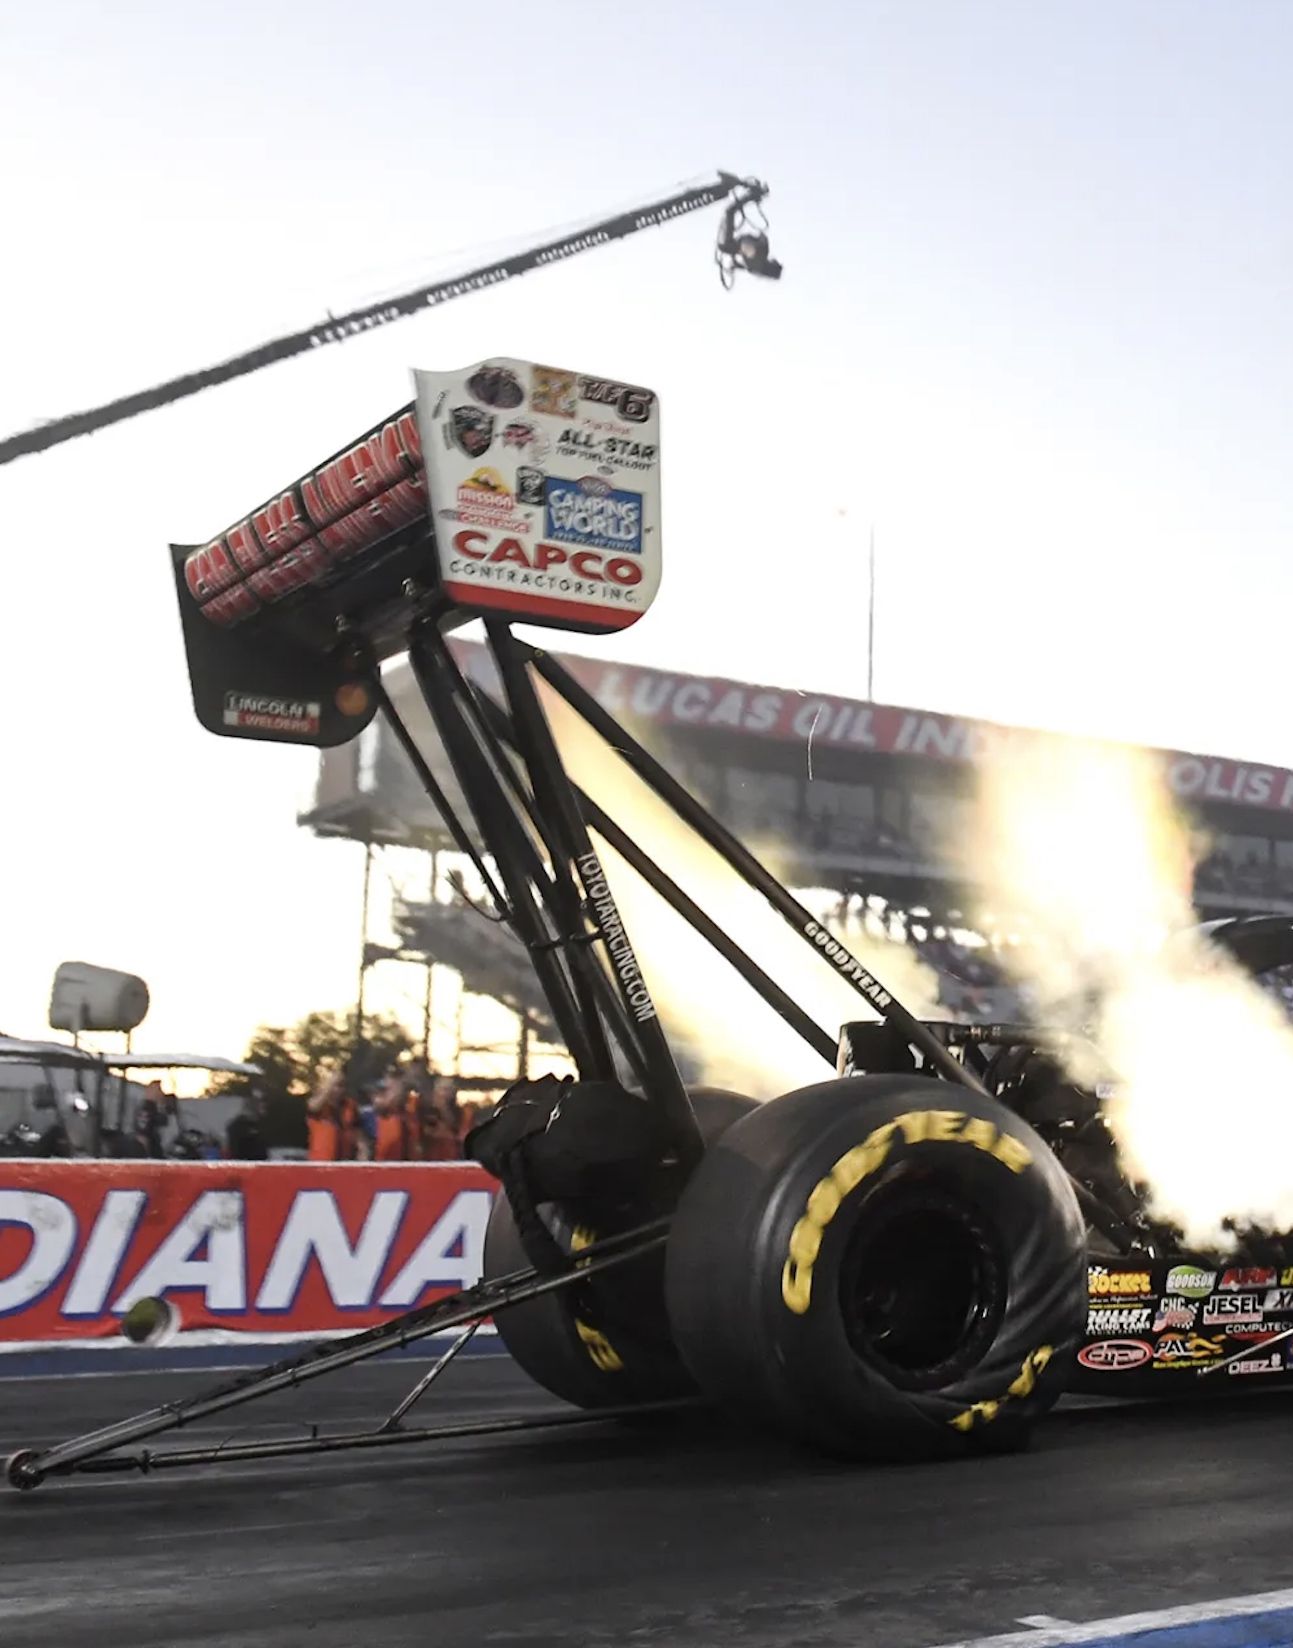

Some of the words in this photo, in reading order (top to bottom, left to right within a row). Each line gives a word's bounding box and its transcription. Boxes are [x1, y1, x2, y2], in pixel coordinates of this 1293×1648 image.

[548, 488, 640, 522] CAMPING
[549, 506, 639, 540] WORLD
[452, 529, 643, 586] CAPCO
[449, 560, 595, 596] CONTRACTORS
[595, 672, 782, 732] LUCAS
[791, 701, 876, 748] OIL
[576, 852, 658, 1024] TOYOTARACING.COM
[803, 920, 893, 1009] GOODYEAR
[1166, 1271, 1216, 1290] GOODSON
[1205, 1297, 1261, 1316] JESEL
